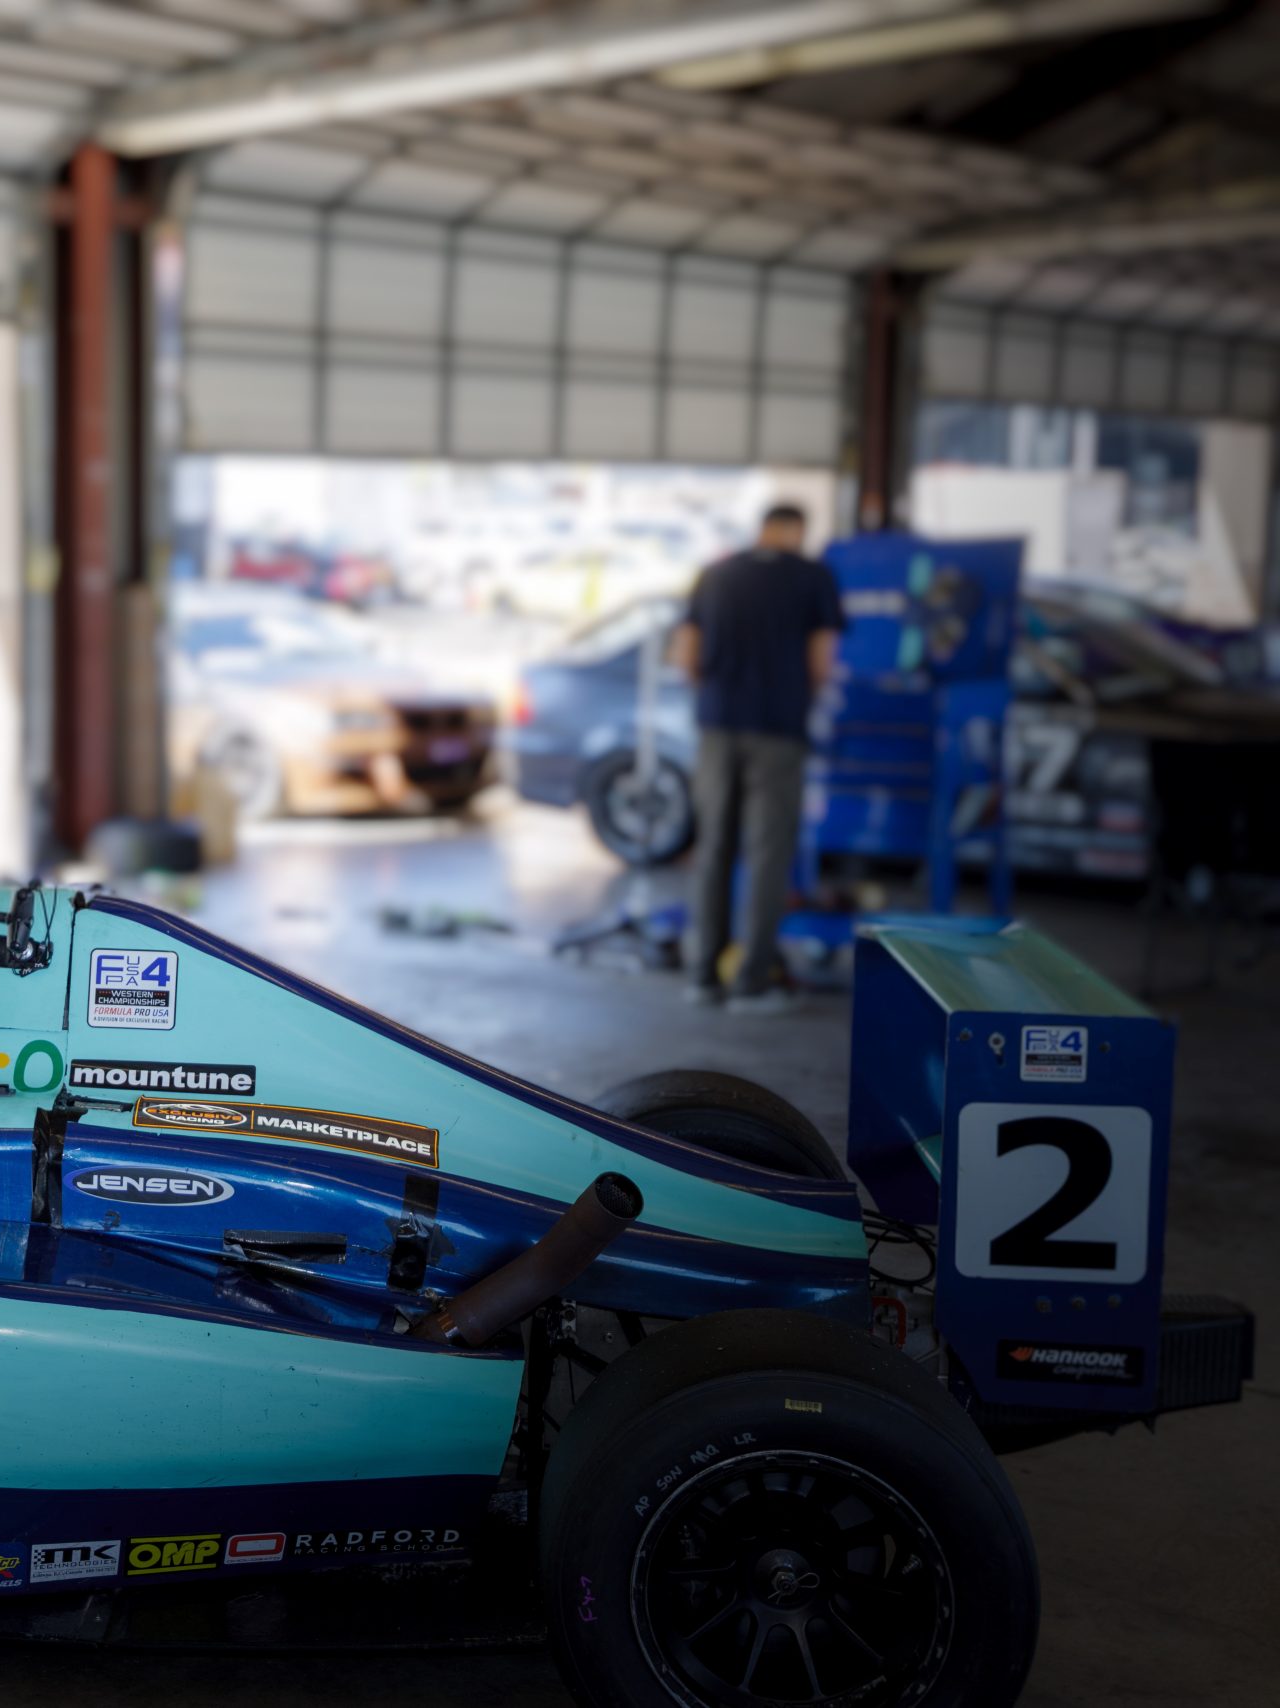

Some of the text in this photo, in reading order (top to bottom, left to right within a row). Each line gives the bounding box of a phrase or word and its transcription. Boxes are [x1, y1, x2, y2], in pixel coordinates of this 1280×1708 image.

[98, 996, 166, 1006] CHAMPIONSHIPS
[111, 989, 154, 998] WESTERN
[94, 1006, 169, 1017] FORMULA PRO USA
[73, 1065, 253, 1091] mountune
[147, 1107, 243, 1121] EXCLUSIVE
[165, 1114, 225, 1125] RACING
[257, 1115, 431, 1157] MARKETPLACE
[76, 1174, 214, 1197] JENSEN
[988, 1116, 1118, 1270] 2
[632, 1494, 651, 1518] AP
[732, 1431, 757, 1446] LR
[295, 1529, 460, 1548] RADFORD
[128, 1540, 220, 1569] OMP
[293, 1545, 366, 1556] RACING
[33, 1559, 117, 1570] TECHNOLOGIES
